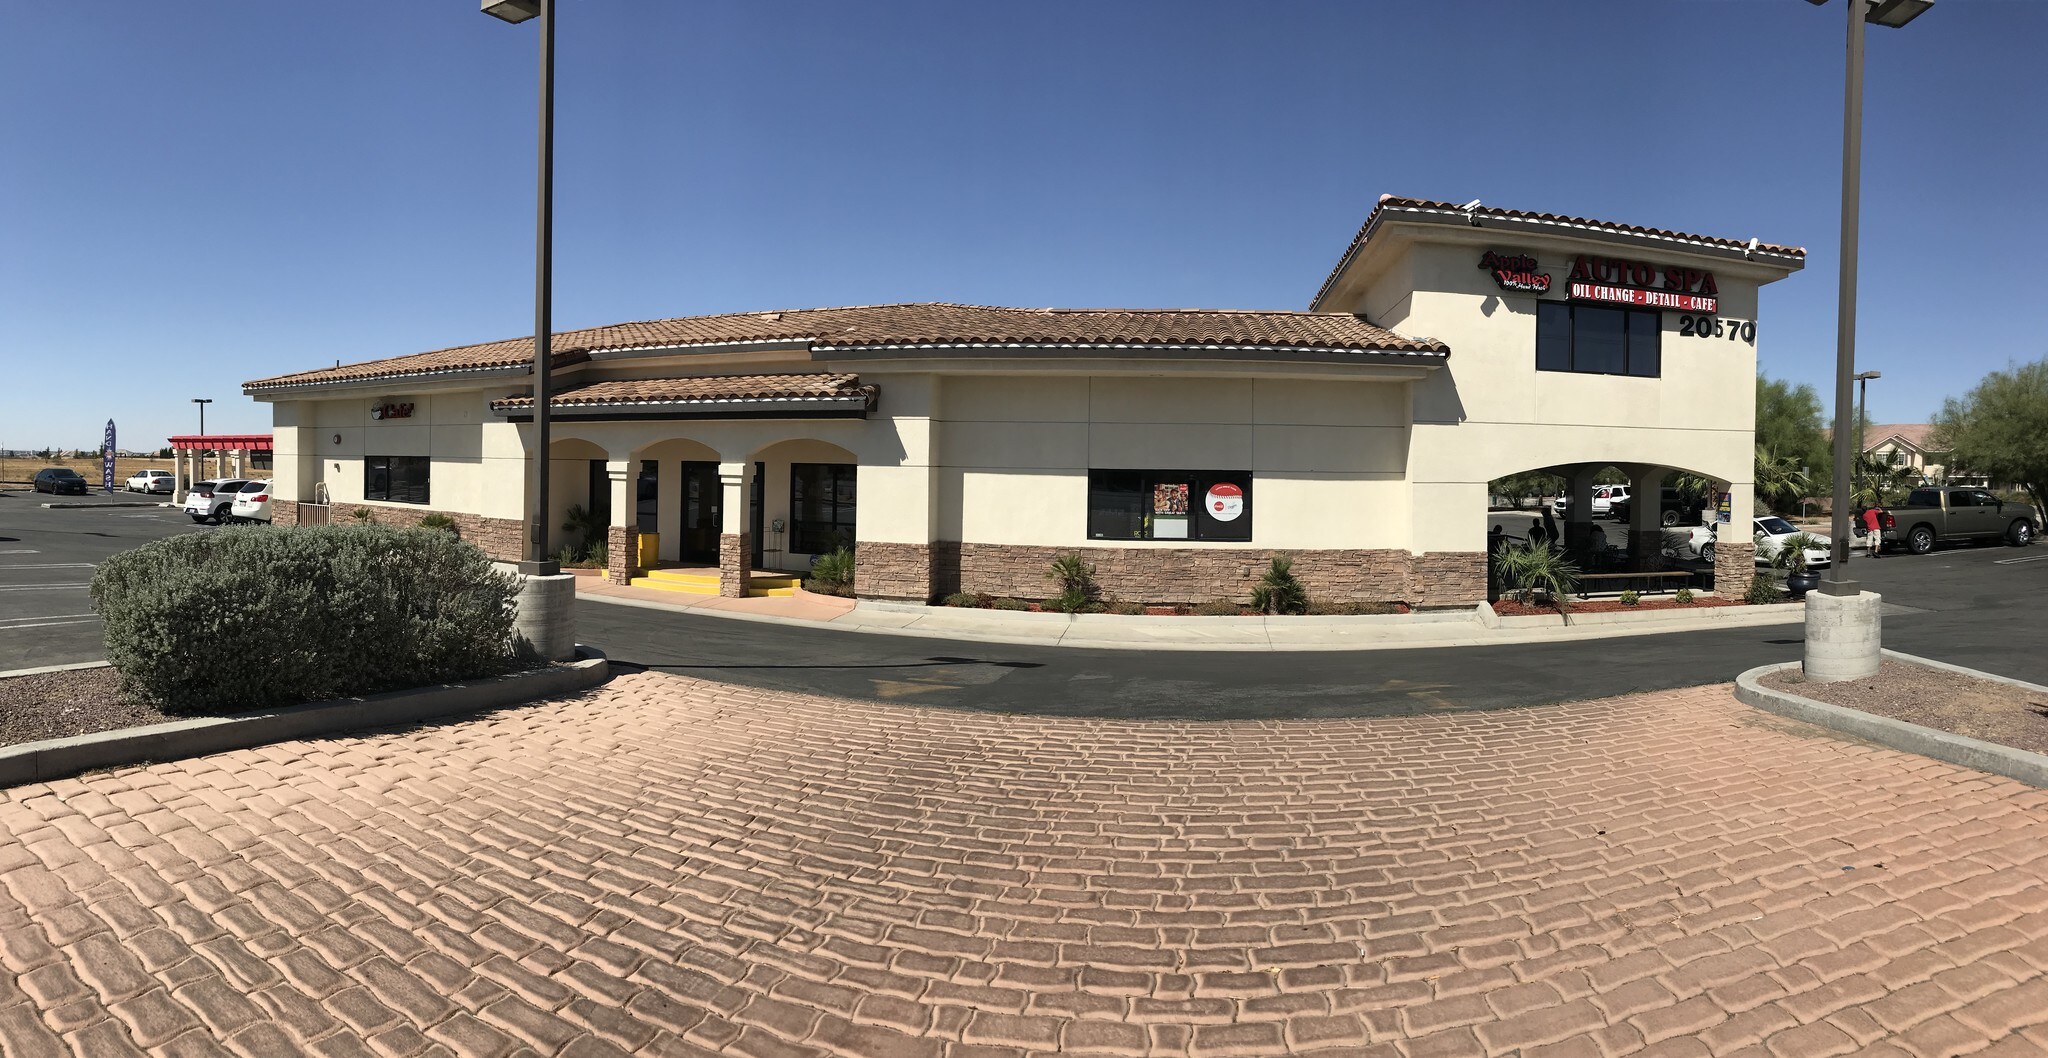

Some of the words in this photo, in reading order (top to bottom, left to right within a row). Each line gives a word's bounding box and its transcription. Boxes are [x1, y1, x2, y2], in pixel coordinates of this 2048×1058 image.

[1481, 252, 1537, 270] Apple
[1497, 269, 1550, 289] Valley
[1568, 255, 1656, 287] AUTO
[1664, 265, 1719, 295] SPA
[1573, 283, 1591, 298] OIL
[1594, 285, 1635, 303] CHANGE
[1645, 291, 1680, 307] DETAIL
[1690, 296, 1716, 311] CAFE'
[1680, 315, 1756, 342] 20570
